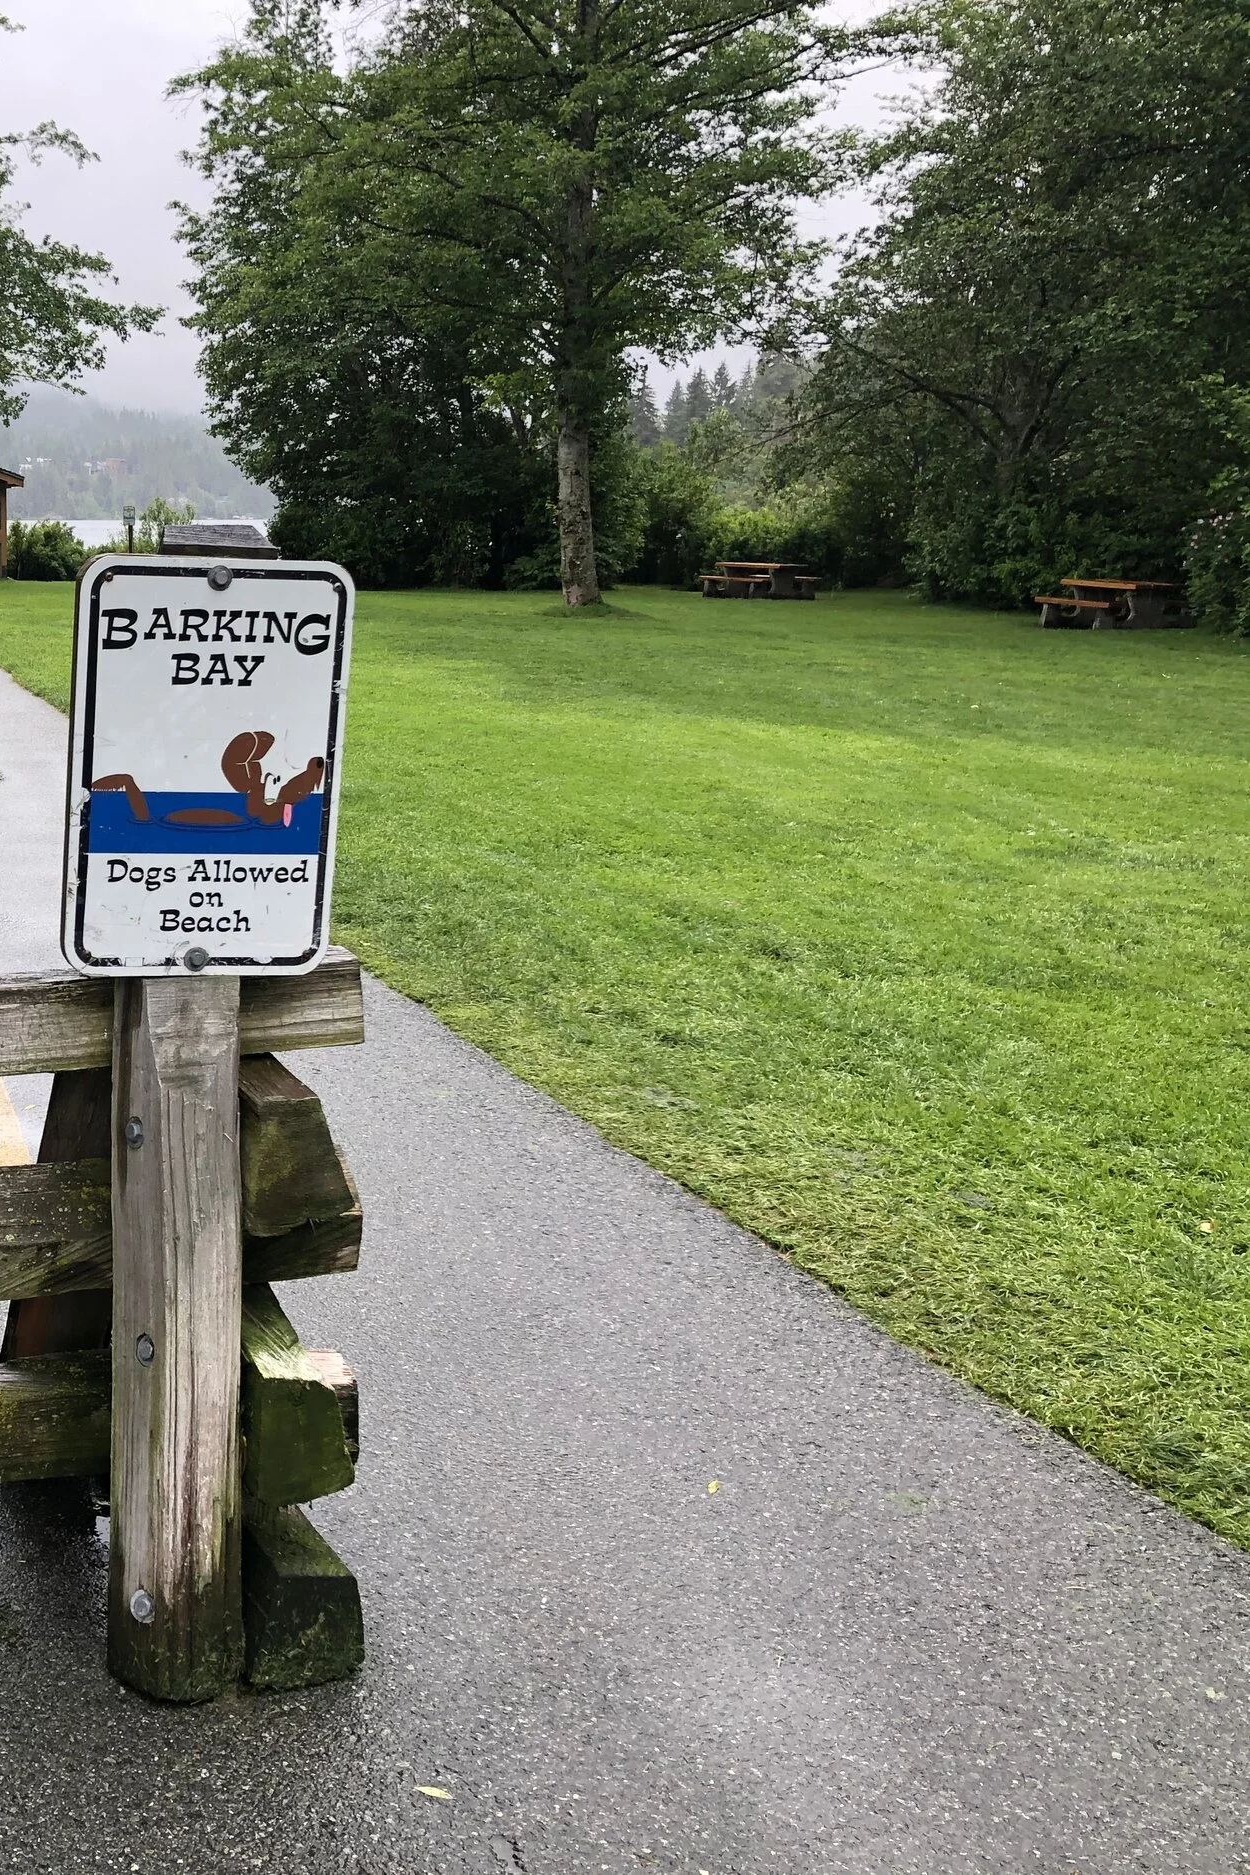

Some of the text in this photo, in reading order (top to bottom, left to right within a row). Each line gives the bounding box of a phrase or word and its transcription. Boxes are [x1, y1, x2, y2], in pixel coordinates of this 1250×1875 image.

[100, 607, 332, 656] BARKING
[171, 652, 266, 687] BAY
[106, 858, 309, 892] Dogs Allowed
[189, 891, 224, 908] on
[159, 909, 251, 933] Beach
